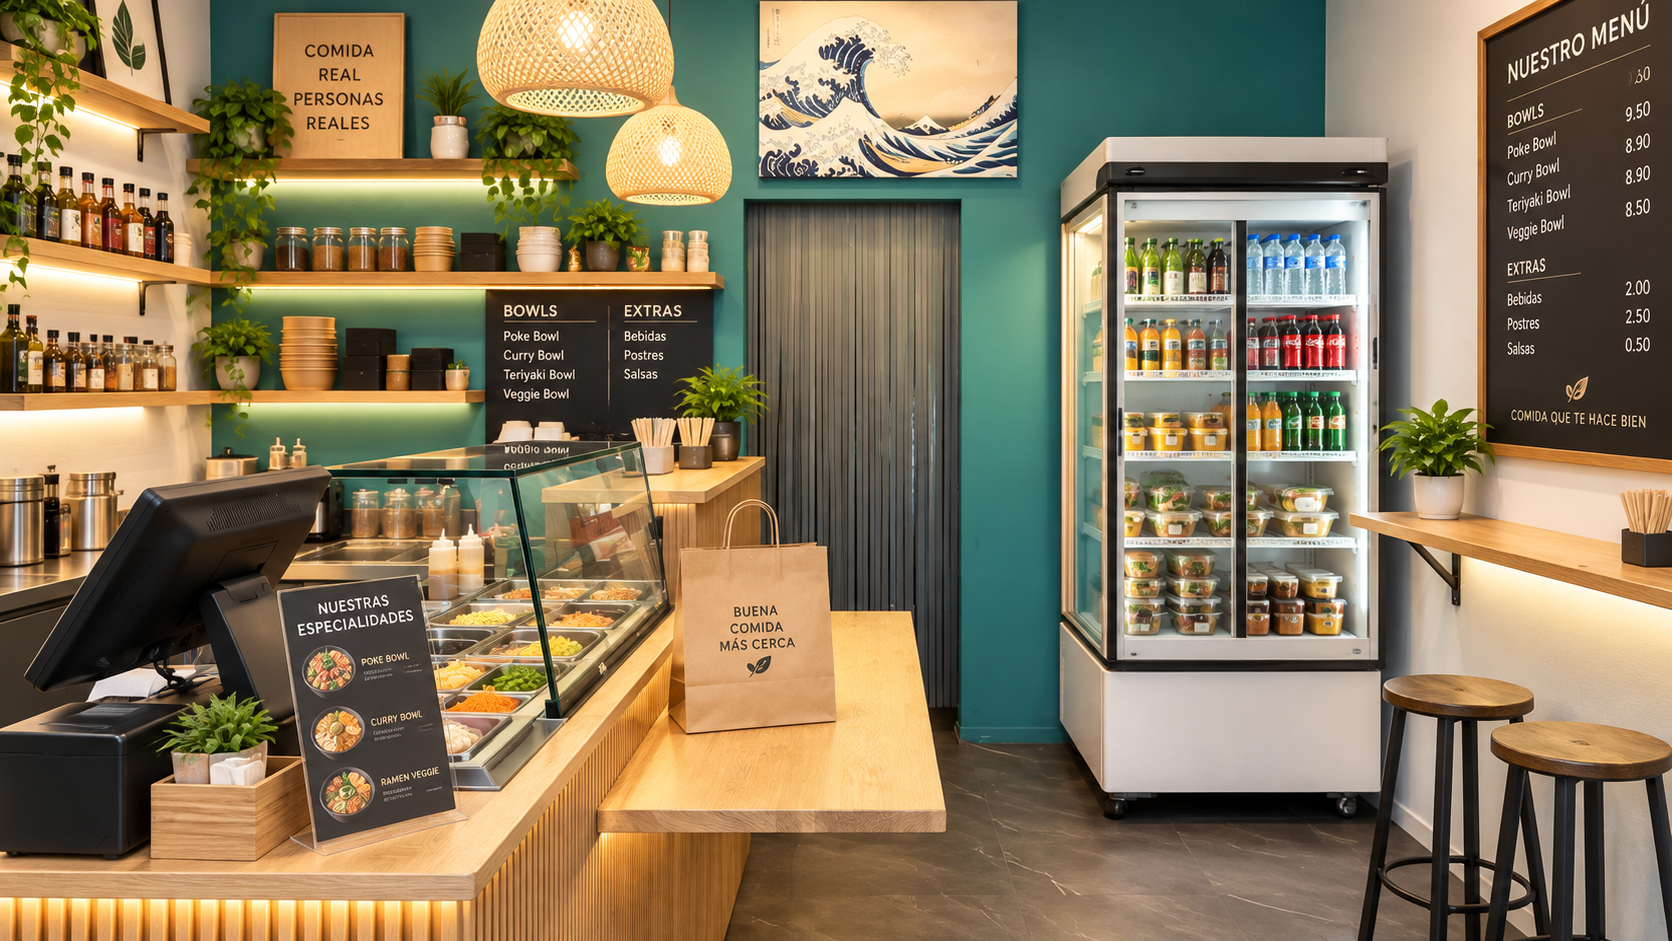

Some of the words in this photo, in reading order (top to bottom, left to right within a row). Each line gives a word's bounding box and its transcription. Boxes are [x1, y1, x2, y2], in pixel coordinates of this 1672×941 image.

[1508, 33, 1585, 83] NUESTRO
[1592, 0, 1649, 49] MENÚ
[305, 44, 373, 57] COMIDA
[319, 68, 360, 81] REAL
[294, 92, 383, 106] PERSONAS
[307, 116, 369, 130] REALES
[1508, 103, 1544, 129] BOWLS
[1508, 143, 1530, 159] Poke
[1533, 131, 1556, 151] Bowl
[1626, 101, 1650, 122] 9.50
[1508, 170, 1533, 186] Curry
[1536, 158, 1559, 178] Bowl
[1626, 133, 1650, 153] 8.90
[1507, 192, 1543, 213] Teriyaki
[1547, 184, 1570, 203] Bowl
[1626, 165, 1650, 184] 8.90
[1507, 222, 1537, 241] Veggie
[1541, 215, 1564, 233] Bowl
[1626, 198, 1650, 217] 8.50
[1508, 258, 1545, 276] EXTRAS
[1508, 291, 1542, 306] Bebidas
[1626, 280, 1650, 296] 2.00
[504, 305, 557, 317] BOWLS
[625, 305, 681, 317] EXTRAS
[1508, 318, 1539, 330] Postres
[1626, 308, 1650, 323] 2.50
[504, 331, 530, 341] Poke
[534, 331, 559, 341] Bowl
[625, 331, 666, 341] Bebidas
[1508, 342, 1534, 355] Salsas
[1626, 337, 1650, 352] 0.50
[504, 350, 534, 363] Curry
[538, 350, 563, 360] Bowl
[625, 350, 663, 360] Postres
[504, 369, 545, 382] Teriyaki
[550, 369, 575, 379] Bowl
[624, 369, 658, 379] Salsas
[503, 388, 540, 402] Veggie
[544, 389, 569, 399] Bowl
[1511, 409, 1547, 422] COMIDA
[1551, 412, 1570, 425] QUE
[1574, 413, 1585, 424] TE
[1589, 413, 1616, 426] HACE
[1622, 415, 1646, 428] BIEN
[318, 595, 389, 614] NUESTRAS
[734, 605, 778, 617] BUENA
[298, 609, 413, 636] ESPECIALIDADES
[730, 622, 783, 634] COMIDA
[720, 638, 747, 651] MÁS
[752, 638, 795, 649] CERCA
[361, 656, 383, 666] POKE
[386, 652, 409, 662] BOWL
[371, 715, 397, 726] CURRY
[400, 711, 422, 721] BOWL
[381, 773, 409, 786] RAMEN
[411, 767, 439, 778] VEGGIE
